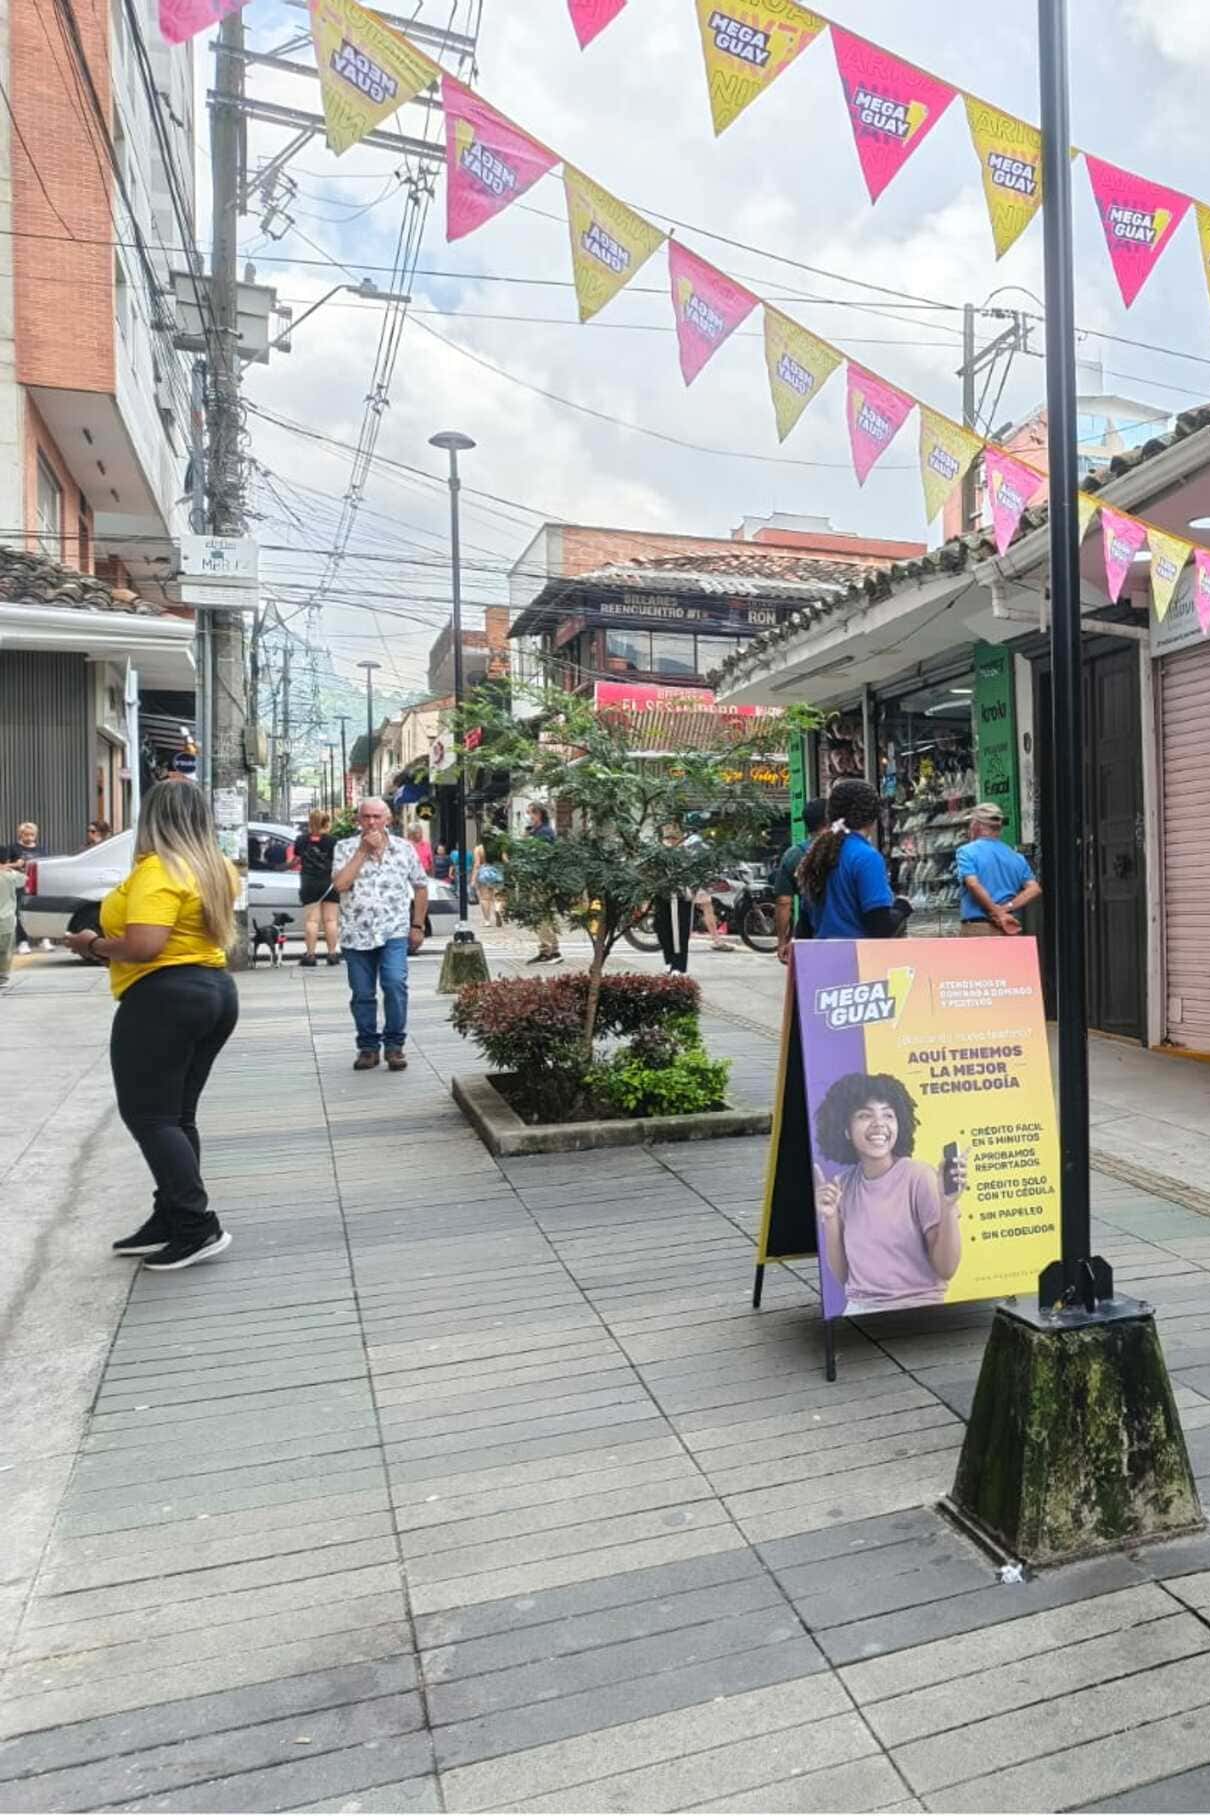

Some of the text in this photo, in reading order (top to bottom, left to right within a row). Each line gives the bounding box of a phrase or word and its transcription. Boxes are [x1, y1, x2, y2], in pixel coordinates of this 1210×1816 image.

[711, 15, 766, 49] MEGA
[716, 33, 769, 65] GUAY
[855, 92, 905, 118] MEGA
[861, 111, 908, 136] GUAY
[989, 154, 1033, 178] MEGA
[993, 171, 1036, 195] GUAY
[1110, 209, 1152, 227] MEGA
[1115, 224, 1155, 242] GUAY
[601, 604, 684, 619] REENCUENTRO
[748, 611, 776, 624] RON
[820, 985, 885, 1011] MEGA
[830, 999, 894, 1026] GUAY
[908, 1046, 1022, 1064] AQUÍ TENEMOS
[930, 1062, 1006, 1078] LA MEJOR
[920, 1077, 1019, 1095] TECNOLOGÍA
[971, 1125, 1014, 1137] CRÉDITO
[972, 1133, 1040, 1147] EN 5 MINUTOS
[974, 1148, 1035, 1162] APROBAMOS
[975, 1159, 1040, 1172] REPORTADOS
[977, 1176, 1047, 1191] CRÉDITO SOLO
[978, 1185, 1055, 1202] CON TU CÉDULA
[980, 1206, 1043, 1220] SIN PAPELEO
[982, 1225, 1056, 1240] SIN CODEUDOR
